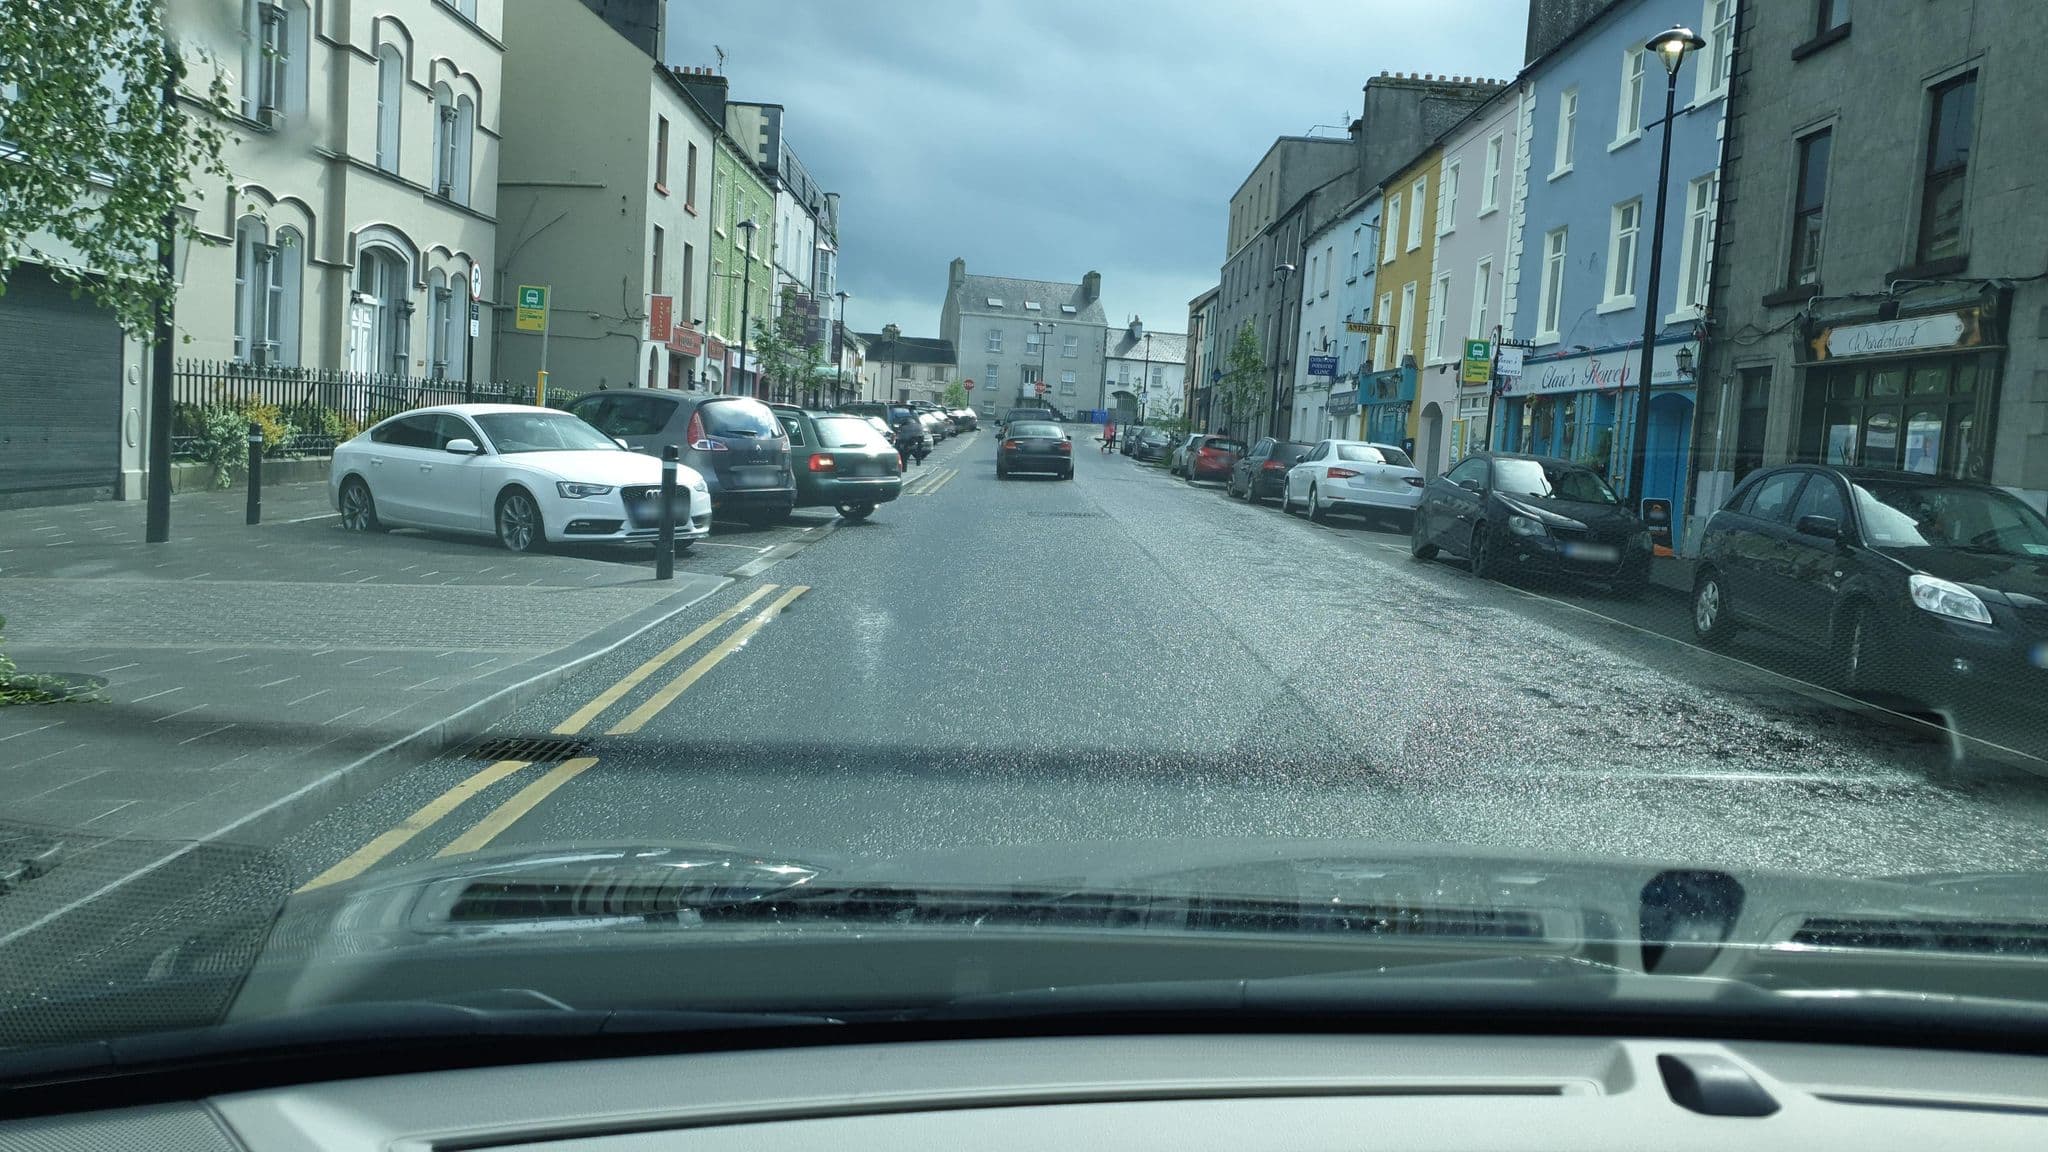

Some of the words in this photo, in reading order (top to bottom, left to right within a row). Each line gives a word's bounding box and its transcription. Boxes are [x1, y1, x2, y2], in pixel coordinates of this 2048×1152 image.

[1347, 325, 1382, 334] ANTIQUES
[1850, 321, 1932, 351] Wonderland
[1542, 364, 1576, 390] Clare's
[1581, 359, 1632, 385] Flowes
